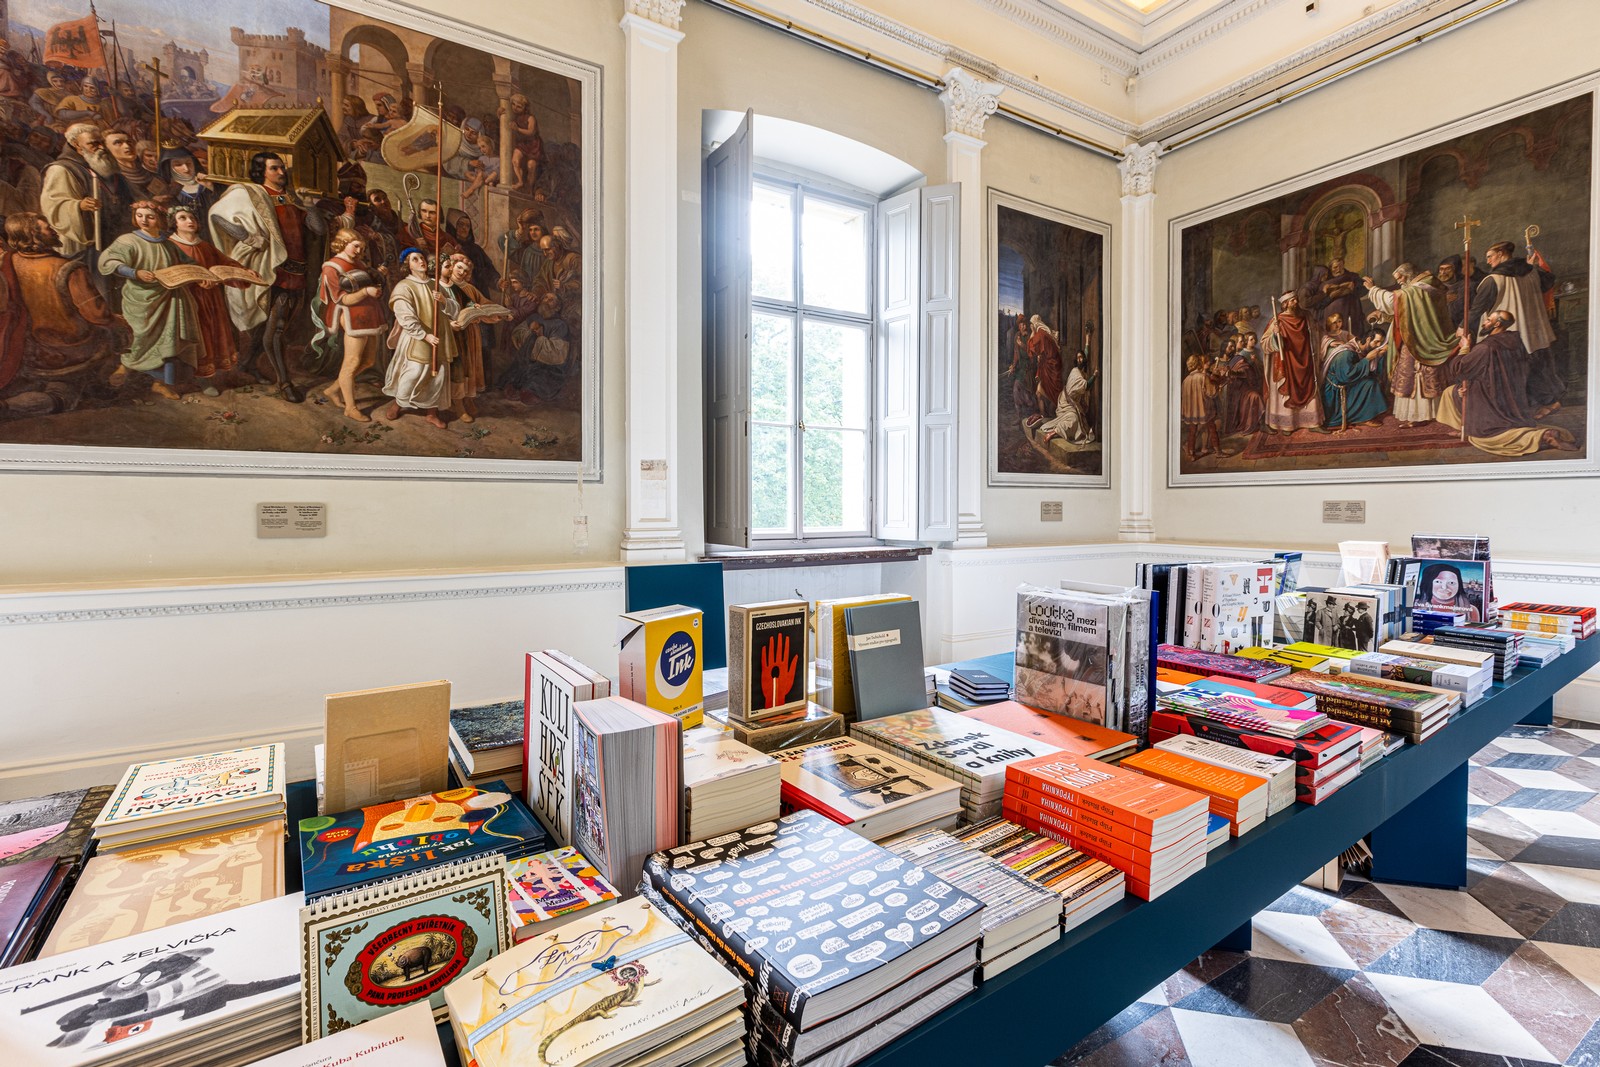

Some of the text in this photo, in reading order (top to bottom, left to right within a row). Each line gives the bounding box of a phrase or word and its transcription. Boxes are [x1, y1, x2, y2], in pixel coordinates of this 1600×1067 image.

[756, 618, 794, 630] CZECHOSLOVAKIAN
[1068, 622, 1096, 635] filmem
[1076, 617, 1096, 626] mezi
[668, 652, 694, 680] Ink
[540, 674, 570, 740] KULI
[937, 740, 994, 758] Seydl
[966, 761, 984, 769] a
[976, 746, 1036, 764] knihy
[125, 786, 258, 816] POVÍDÁNÍ
[1041, 782, 1114, 816] TYPOKNIHA Filip Blažek
[1040, 798, 1113, 832] TYPOKNIHA Filip Blažek
[360, 832, 459, 856] oblohu
[1040, 812, 1072, 833] TYPOKNIHA
[1098, 836, 1112, 849] Filip
[1040, 826, 1072, 846] TYPOKNIHA
[378, 841, 445, 859] vymalovala
[439, 838, 476, 853] Jak
[346, 850, 438, 873] liška
[734, 848, 880, 907] Signals from the Unknown
[96, 960, 114, 970] A
[121, 927, 236, 963] ŽELVIČKA
[367, 918, 456, 956] VŠEOBECNÝ ZVÍŘETNÍK
[366, 958, 462, 1002] PANA PROFESORA REVILLODA
[322, 1034, 405, 1067] Kuba Kubikula
